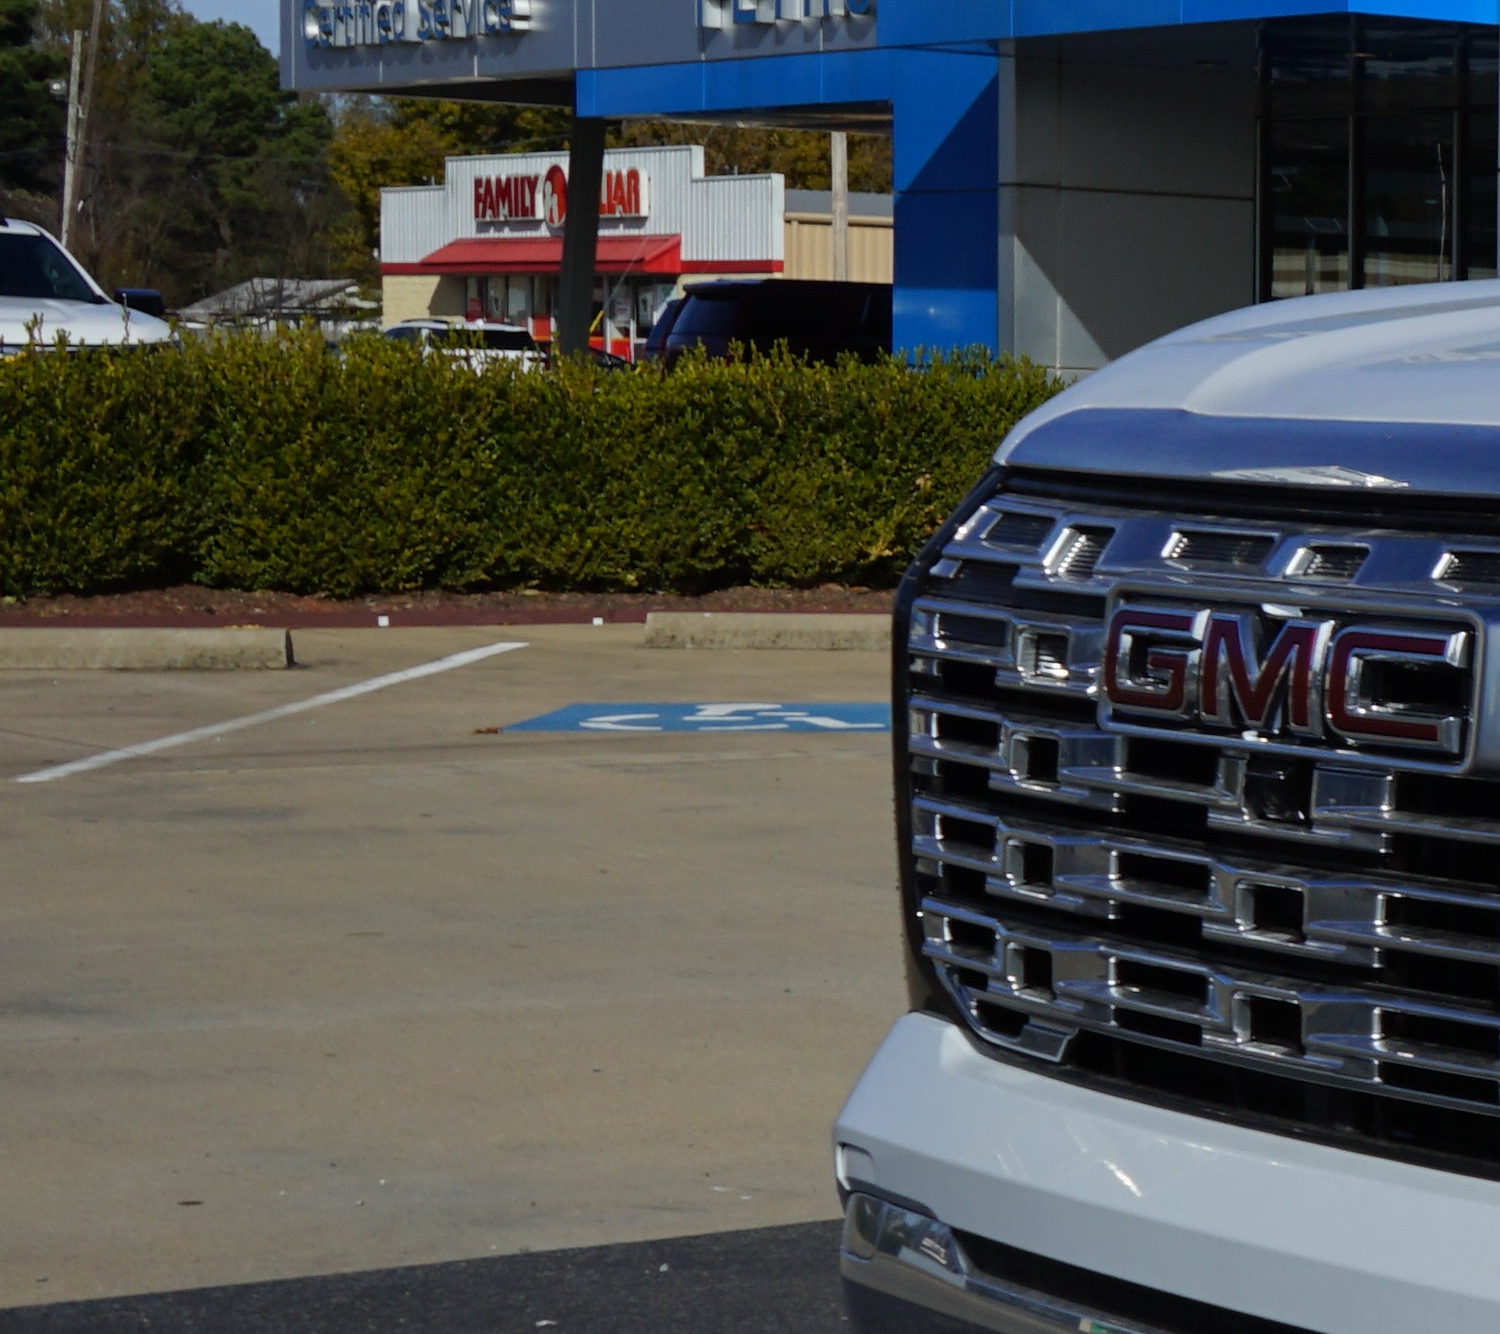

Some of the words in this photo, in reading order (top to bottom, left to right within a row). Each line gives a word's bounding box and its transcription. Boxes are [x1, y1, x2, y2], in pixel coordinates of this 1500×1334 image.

[474, 175, 542, 218] FAMILY
[600, 169, 641, 215] LAR
[1103, 603, 1469, 755] GMC
